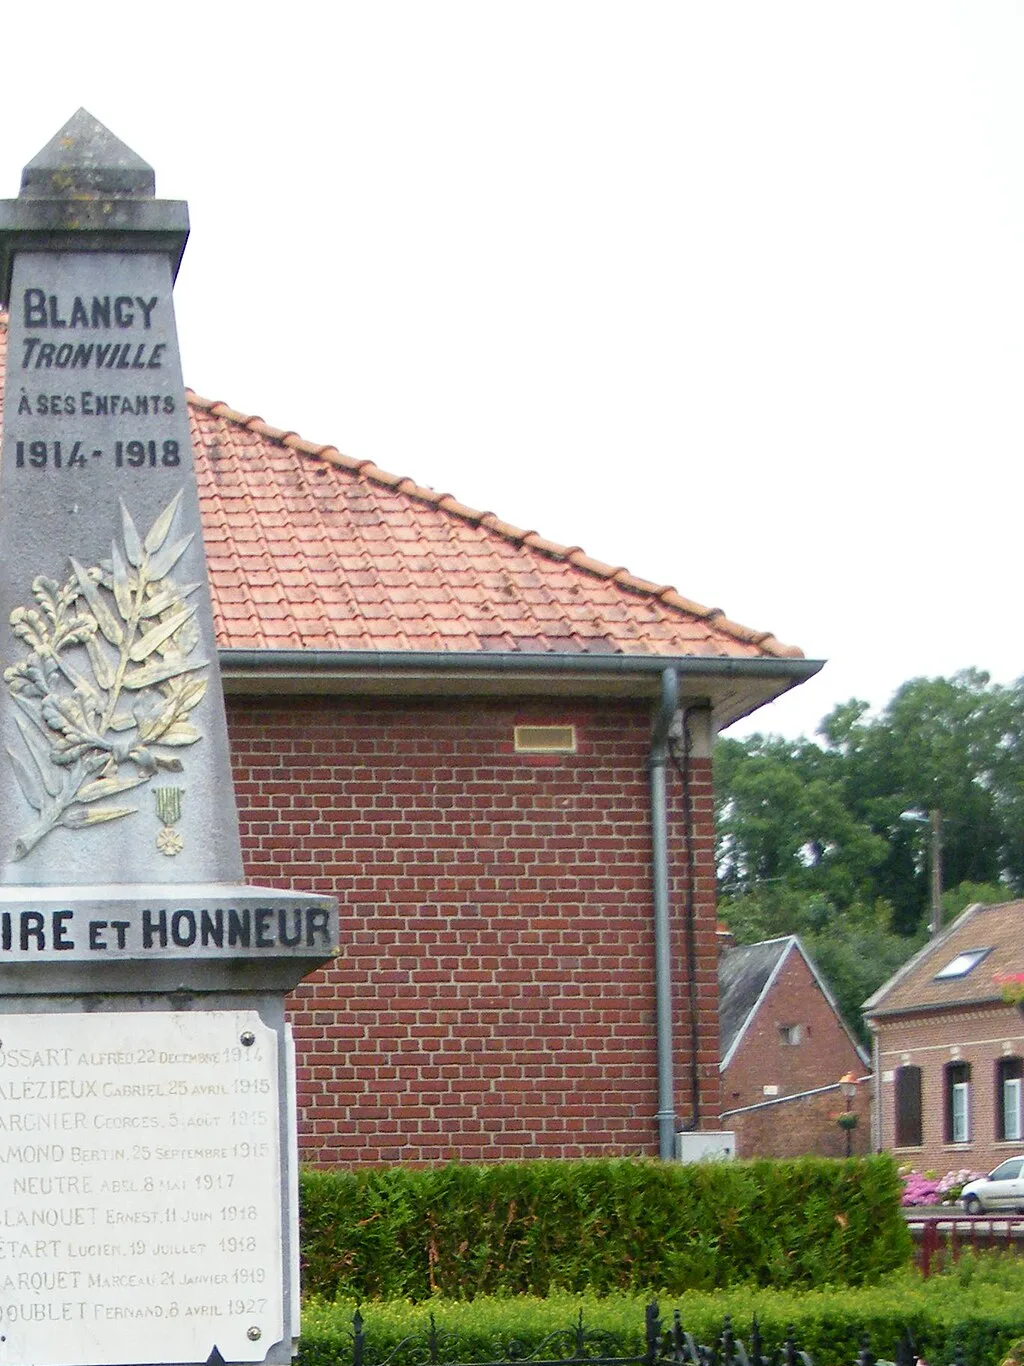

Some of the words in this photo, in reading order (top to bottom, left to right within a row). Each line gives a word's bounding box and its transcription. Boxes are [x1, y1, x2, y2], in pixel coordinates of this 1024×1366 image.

[24, 288, 158, 329] BLANGY
[21, 338, 166, 369] TRONVILLE
[36, 391, 75, 416] SES
[80, 390, 175, 416] ENFANTS
[114, 441, 181, 468] 1918
[89, 920, 131, 950] ET
[142, 907, 332, 949] HONNEUR
[137, 1048, 155, 1064] 22
[167, 1080, 188, 1096] 25
[191, 1084, 229, 1097] AVRIL
[232, 1078, 270, 1094] 1915
[132, 1145, 151, 1161] 25
[155, 1147, 227, 1161] SEPTEMBRE
[231, 1142, 269, 1158] 1915
[13, 1175, 93, 1195] NEUTRE
[144, 1176, 154, 1192] 8
[195, 1174, 234, 1191] 1917
[181, 1209, 213, 1224] JUIN
[220, 1205, 258, 1221] 1918
[128, 1240, 146, 1256] 19
[152, 1242, 207, 1256] JUILLET
[219, 1236, 257, 1253] 1918
[180, 1272, 228, 1287] JANVIER
[232, 1268, 266, 1285] 1919
[184, 1305, 223, 1318] AVRIL
[227, 1298, 268, 1316] 1927
